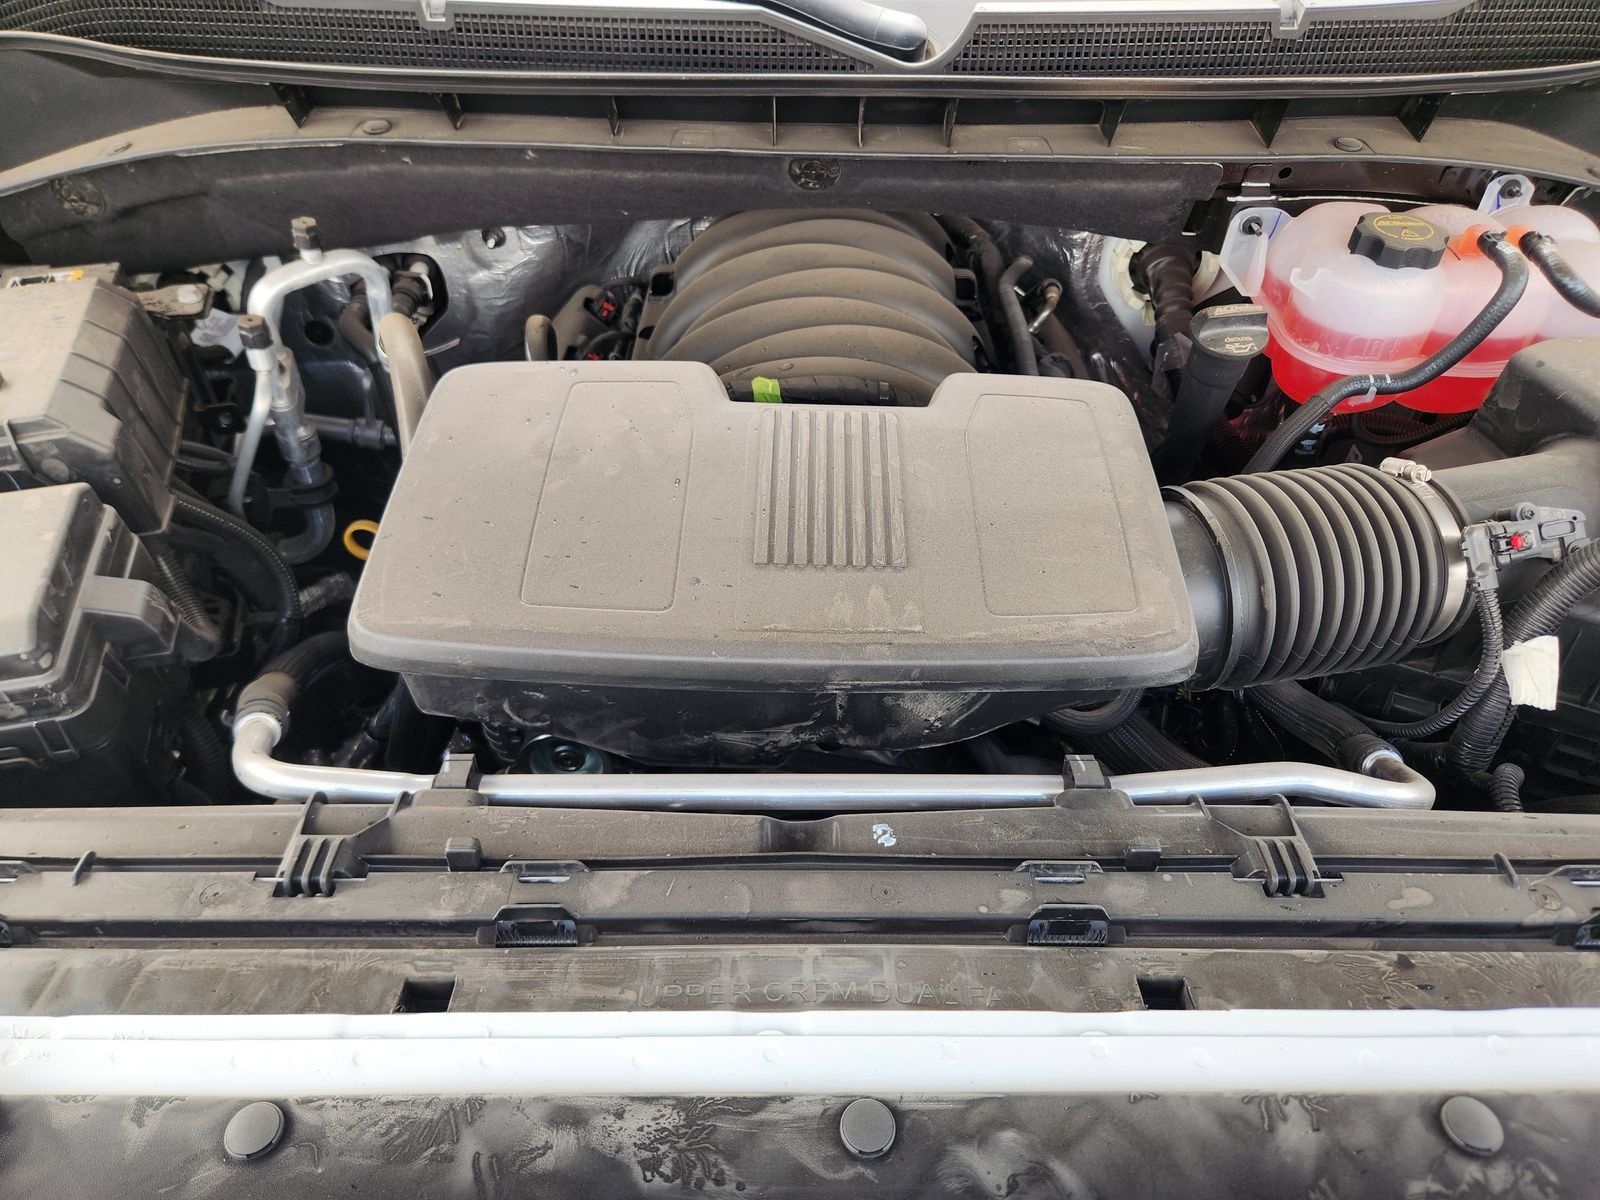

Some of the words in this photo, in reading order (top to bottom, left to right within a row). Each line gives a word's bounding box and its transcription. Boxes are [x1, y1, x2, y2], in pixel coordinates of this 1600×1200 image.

[1214, 304, 1264, 316] ACDelco
[638, 982, 752, 1008] UPPER
[870, 981, 960, 1007] DUAL
